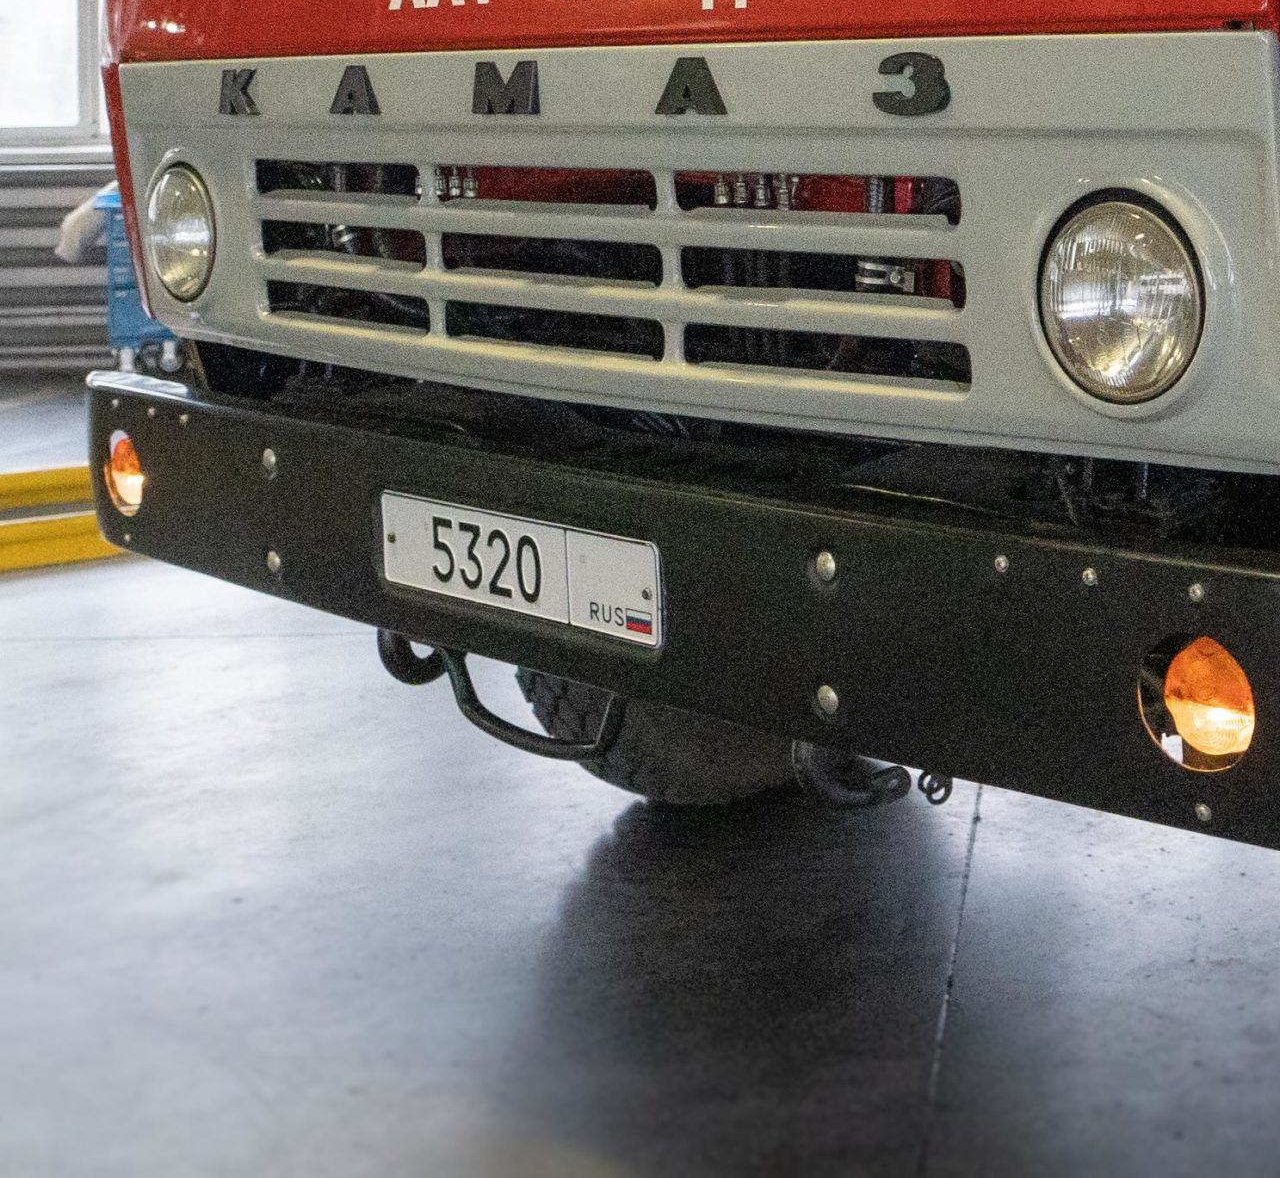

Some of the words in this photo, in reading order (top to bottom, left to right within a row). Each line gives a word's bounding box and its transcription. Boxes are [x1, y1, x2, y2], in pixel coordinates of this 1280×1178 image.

[219, 51, 951, 116] КАМАЗ
[432, 516, 542, 603] 5320
[590, 601, 625, 627] RUS
